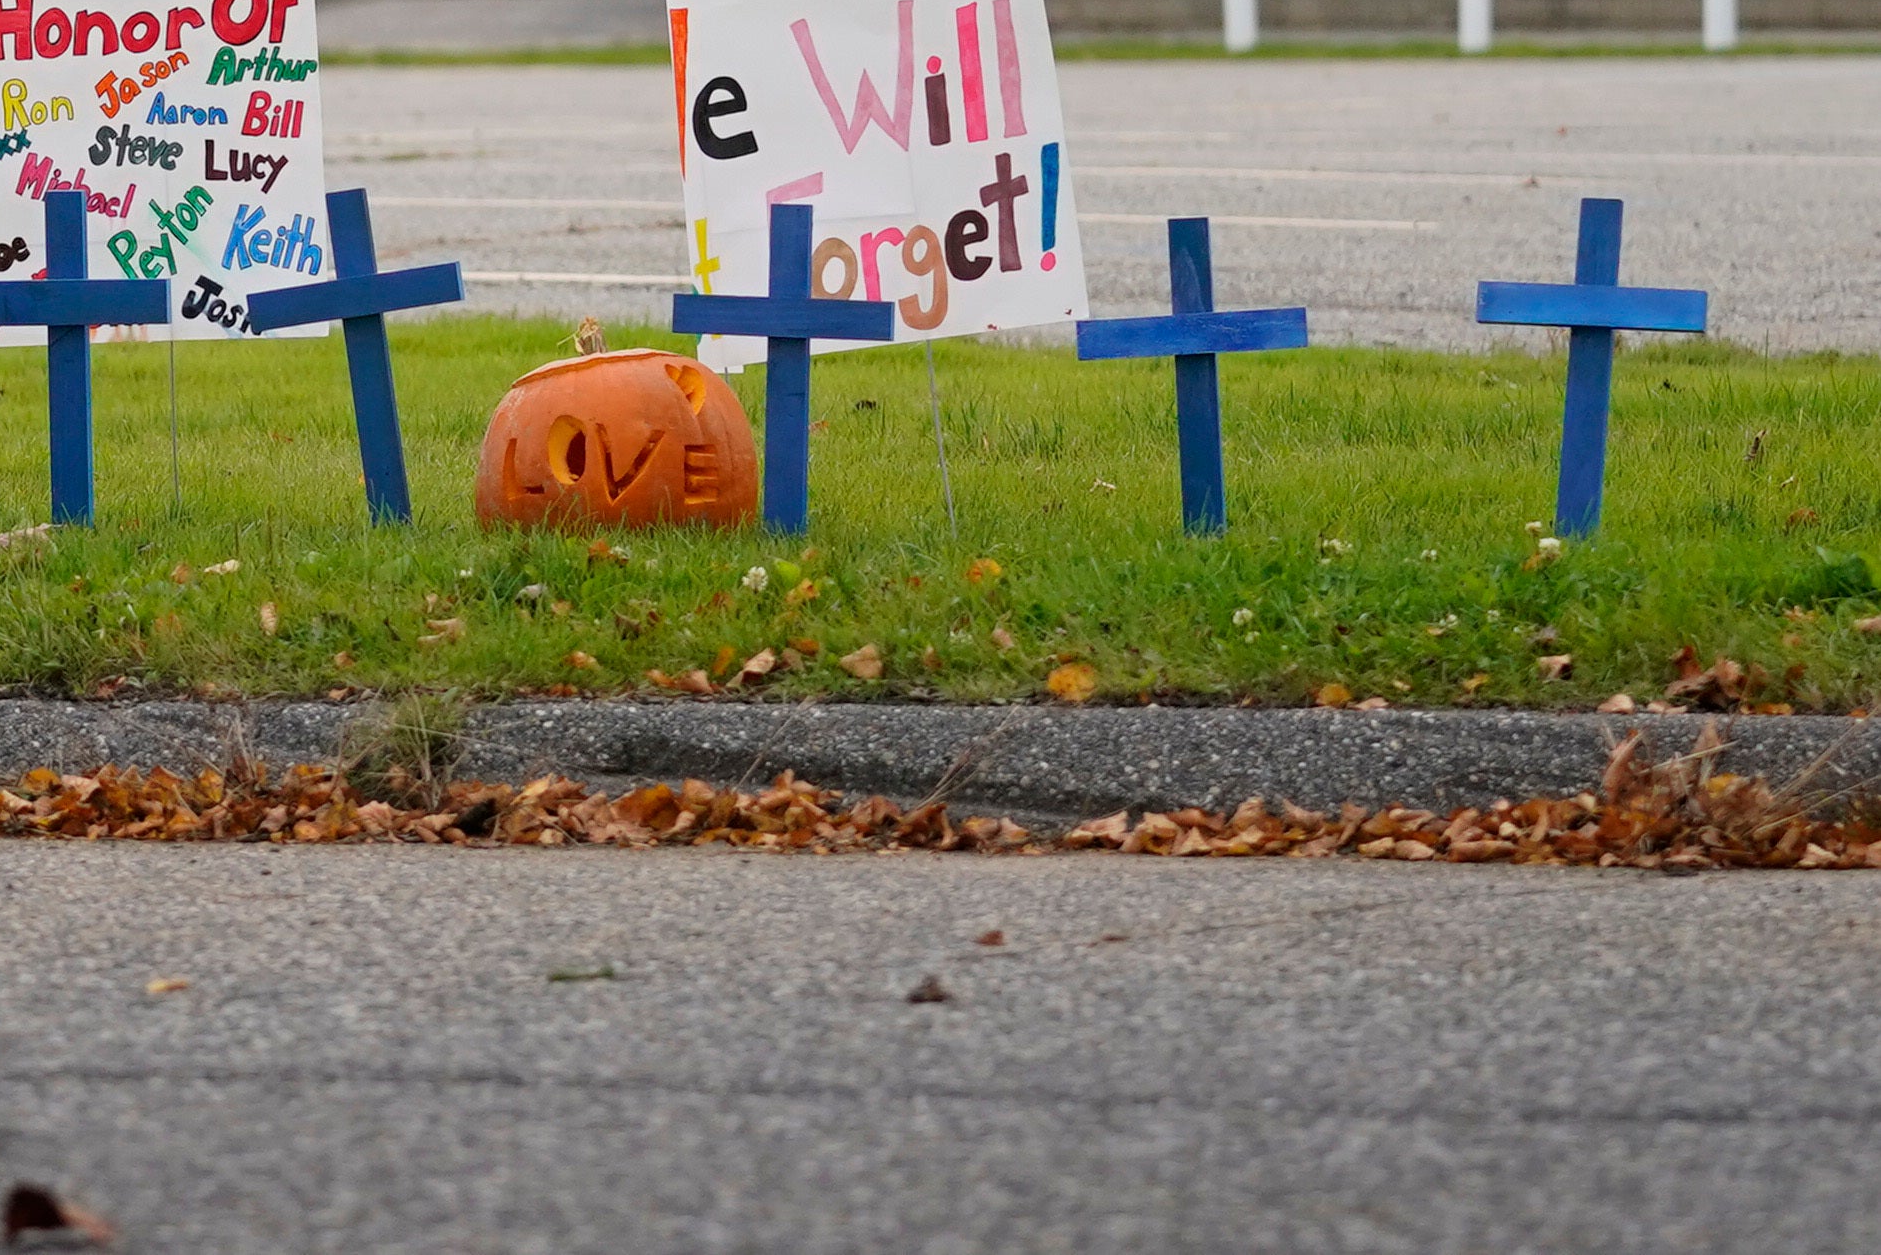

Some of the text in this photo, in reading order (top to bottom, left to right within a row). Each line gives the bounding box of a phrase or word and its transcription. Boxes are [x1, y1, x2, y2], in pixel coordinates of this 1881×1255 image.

[95, 52, 189, 118] Jason
[206, 46, 318, 86] Arthur
[2, 79, 73, 132] Ron
[146, 92, 227, 125] Aaron
[242, 91, 304, 138] Bill
[89, 124, 183, 170] Steve
[205, 140, 288, 194] Lucy
[107, 186, 213, 278] Peyton
[222, 205, 322, 275] Keith
[766, 142, 1060, 331] orget!
[502, 415, 719, 506] LOVE
